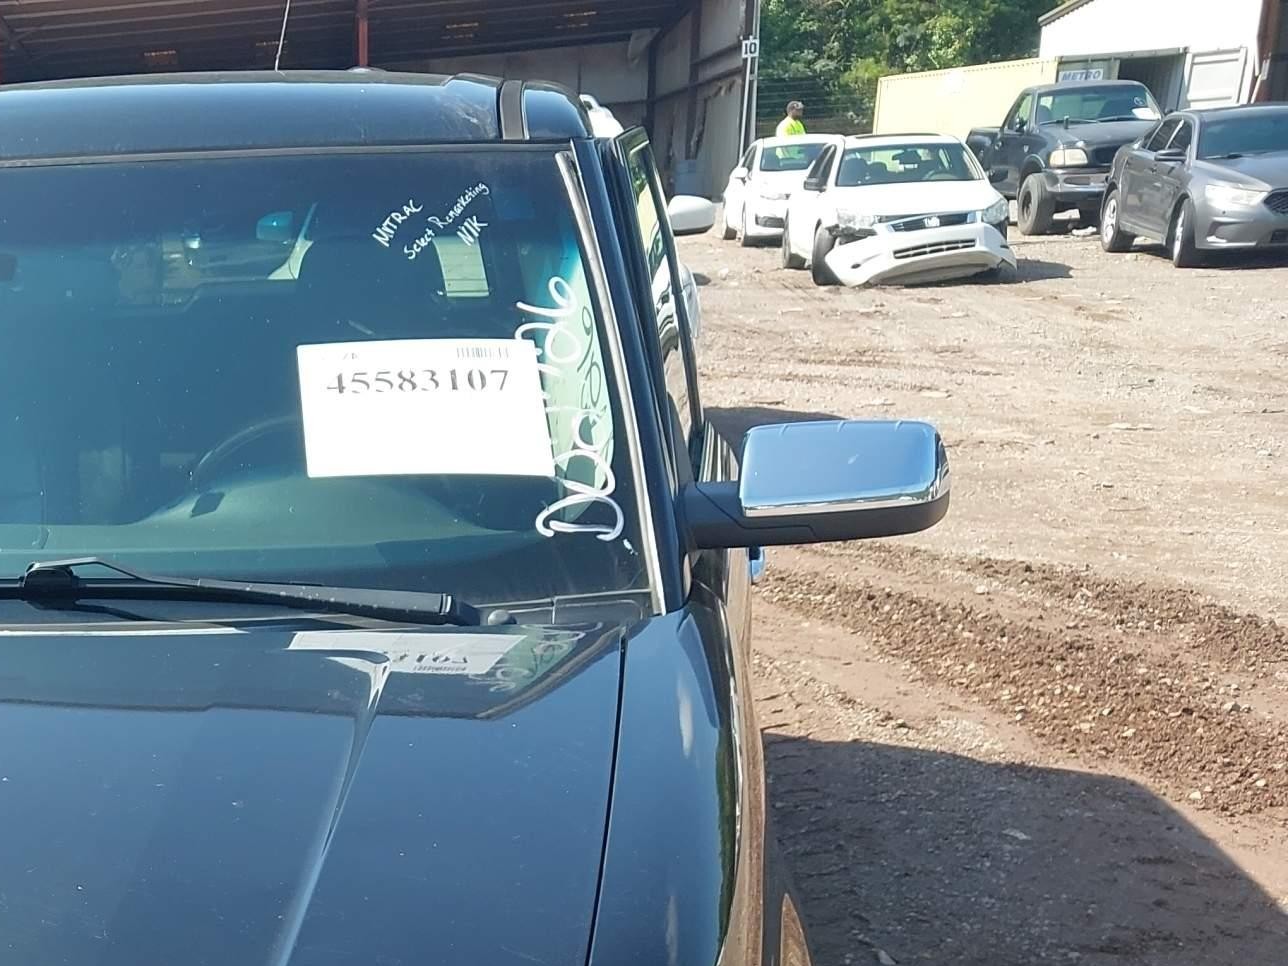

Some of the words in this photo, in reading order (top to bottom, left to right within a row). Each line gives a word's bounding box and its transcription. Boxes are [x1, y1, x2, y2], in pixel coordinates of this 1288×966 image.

[744, 42, 757, 55] 10
[1062, 70, 1101, 80] METRO
[404, 227, 436, 260] Select
[427, 182, 490, 229] Remarketing
[456, 215, 488, 246] NIK
[327, 368, 509, 394] 45583107
